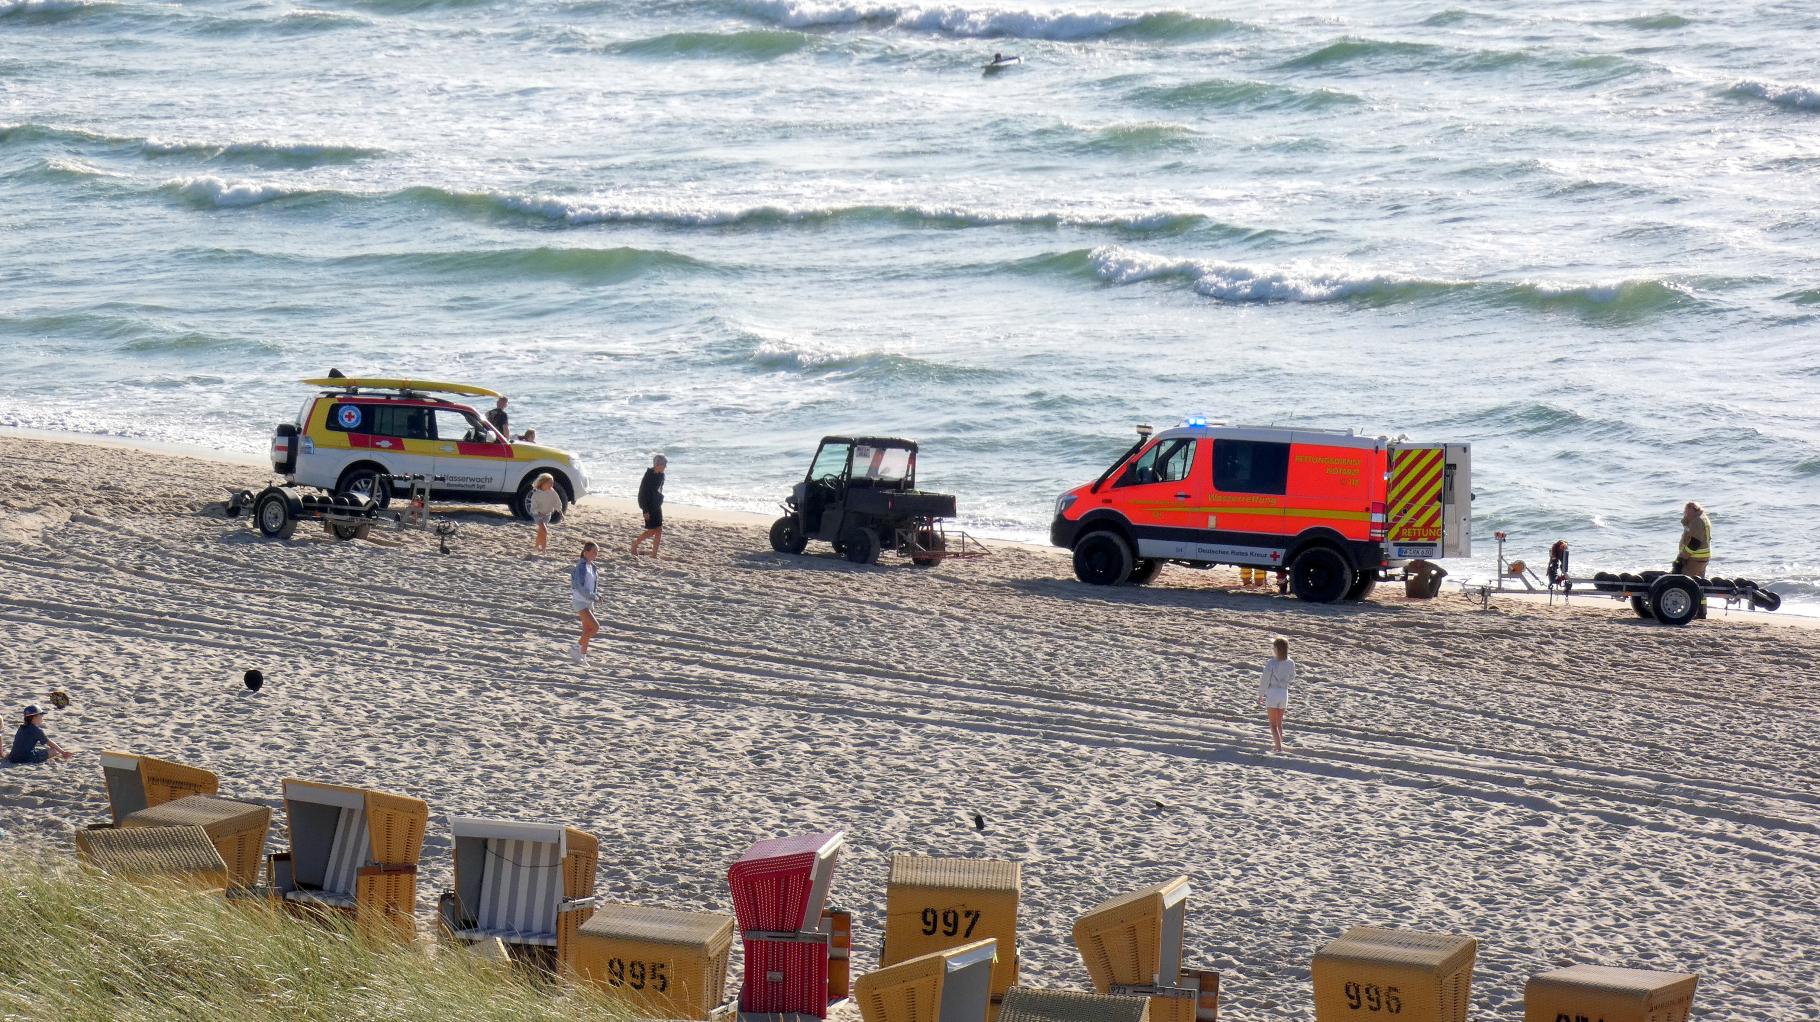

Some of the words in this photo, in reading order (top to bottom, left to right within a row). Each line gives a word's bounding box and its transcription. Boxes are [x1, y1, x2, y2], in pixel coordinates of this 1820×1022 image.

[446, 474, 493, 483] asserwacht
[1402, 528, 1441, 537] RETTUNG
[921, 908, 980, 938] 997
[608, 958, 667, 993] 995
[1344, 981, 1403, 1015] 996
